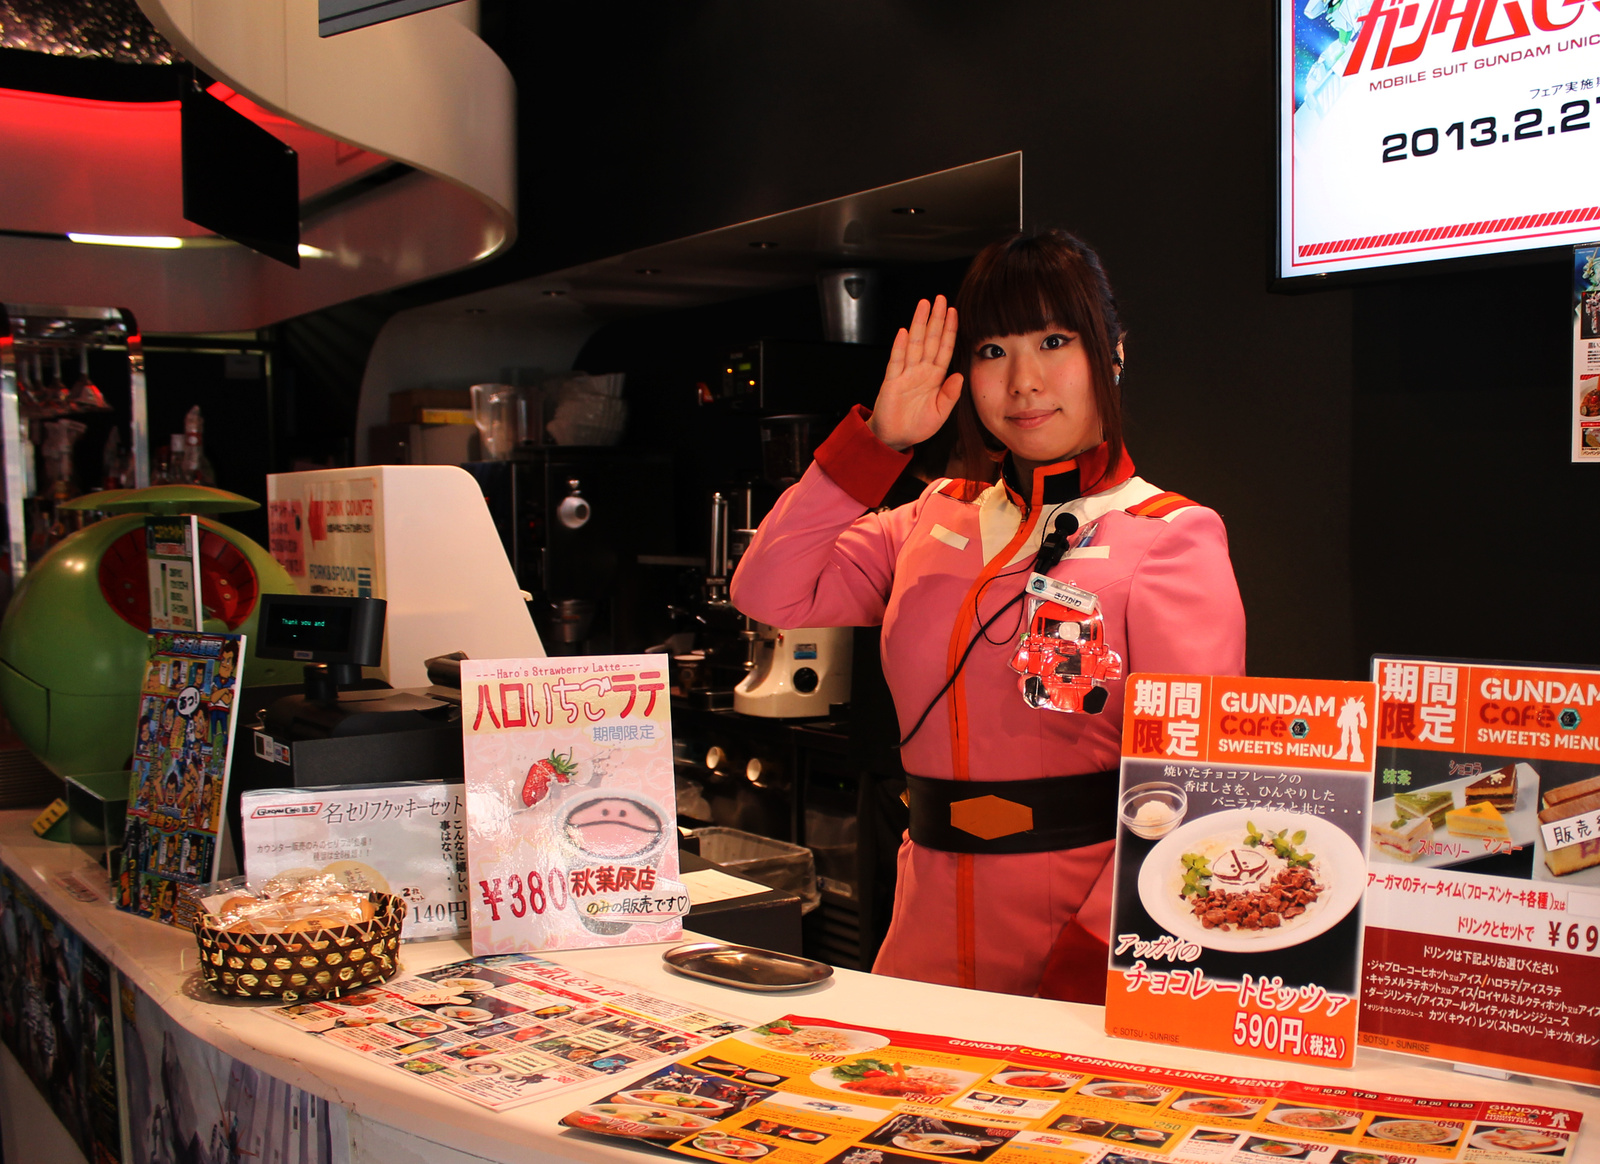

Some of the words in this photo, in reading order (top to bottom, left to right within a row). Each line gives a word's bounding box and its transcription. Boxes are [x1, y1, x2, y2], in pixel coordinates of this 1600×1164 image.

[1369, 71, 1427, 91] MOBILE
[1432, 62, 1469, 78] SUIT
[1474, 44, 1551, 70] GUNDAM
[1529, 77, 1600, 99] フェア実施
[1382, 97, 1600, 163] 2013.2.2
[532, 665, 589, 677] Strawberry
[1383, 663, 1459, 706] 期間
[473, 671, 665, 731] ハロいちごラテ
[1133, 679, 1202, 718] 期間
[1220, 691, 1336, 717] GUNDAM
[592, 724, 655, 742] 期間限定
[1132, 718, 1200, 757] 限定
[1380, 702, 1457, 744] 限定
[1477, 727, 1551, 747] SWEETS
[1218, 738, 1284, 756] SWEETS
[1286, 742, 1334, 758] MENU
[1163, 765, 1302, 784] 焼いたチョコフレークの
[1382, 768, 1412, 786] 抹茶
[1449, 760, 1483, 776] ショコラ
[323, 796, 463, 825] 名セリフクッキーセット
[1553, 815, 1600, 846] 販売
[453, 820, 468, 893] こんなに嬉しい
[479, 867, 568, 921] ¥380
[570, 865, 657, 898] 秋葉原店
[413, 900, 468, 924] 140円
[1458, 916, 1535, 943] ドリンクとセットで
[1115, 934, 1202, 962] アッガイの
[1423, 945, 1559, 975] ドリンクは下記よりお選びください
[1124, 961, 1351, 1017] チョコレートピッツァ
[948, 1038, 1017, 1053] GUNDAM
[1064, 1054, 1147, 1073] MORNING
[1164, 1068, 1228, 1084] LUNCH
[1229, 1077, 1285, 1089] MENU
[1489, 1104, 1553, 1116] GUNDAM
